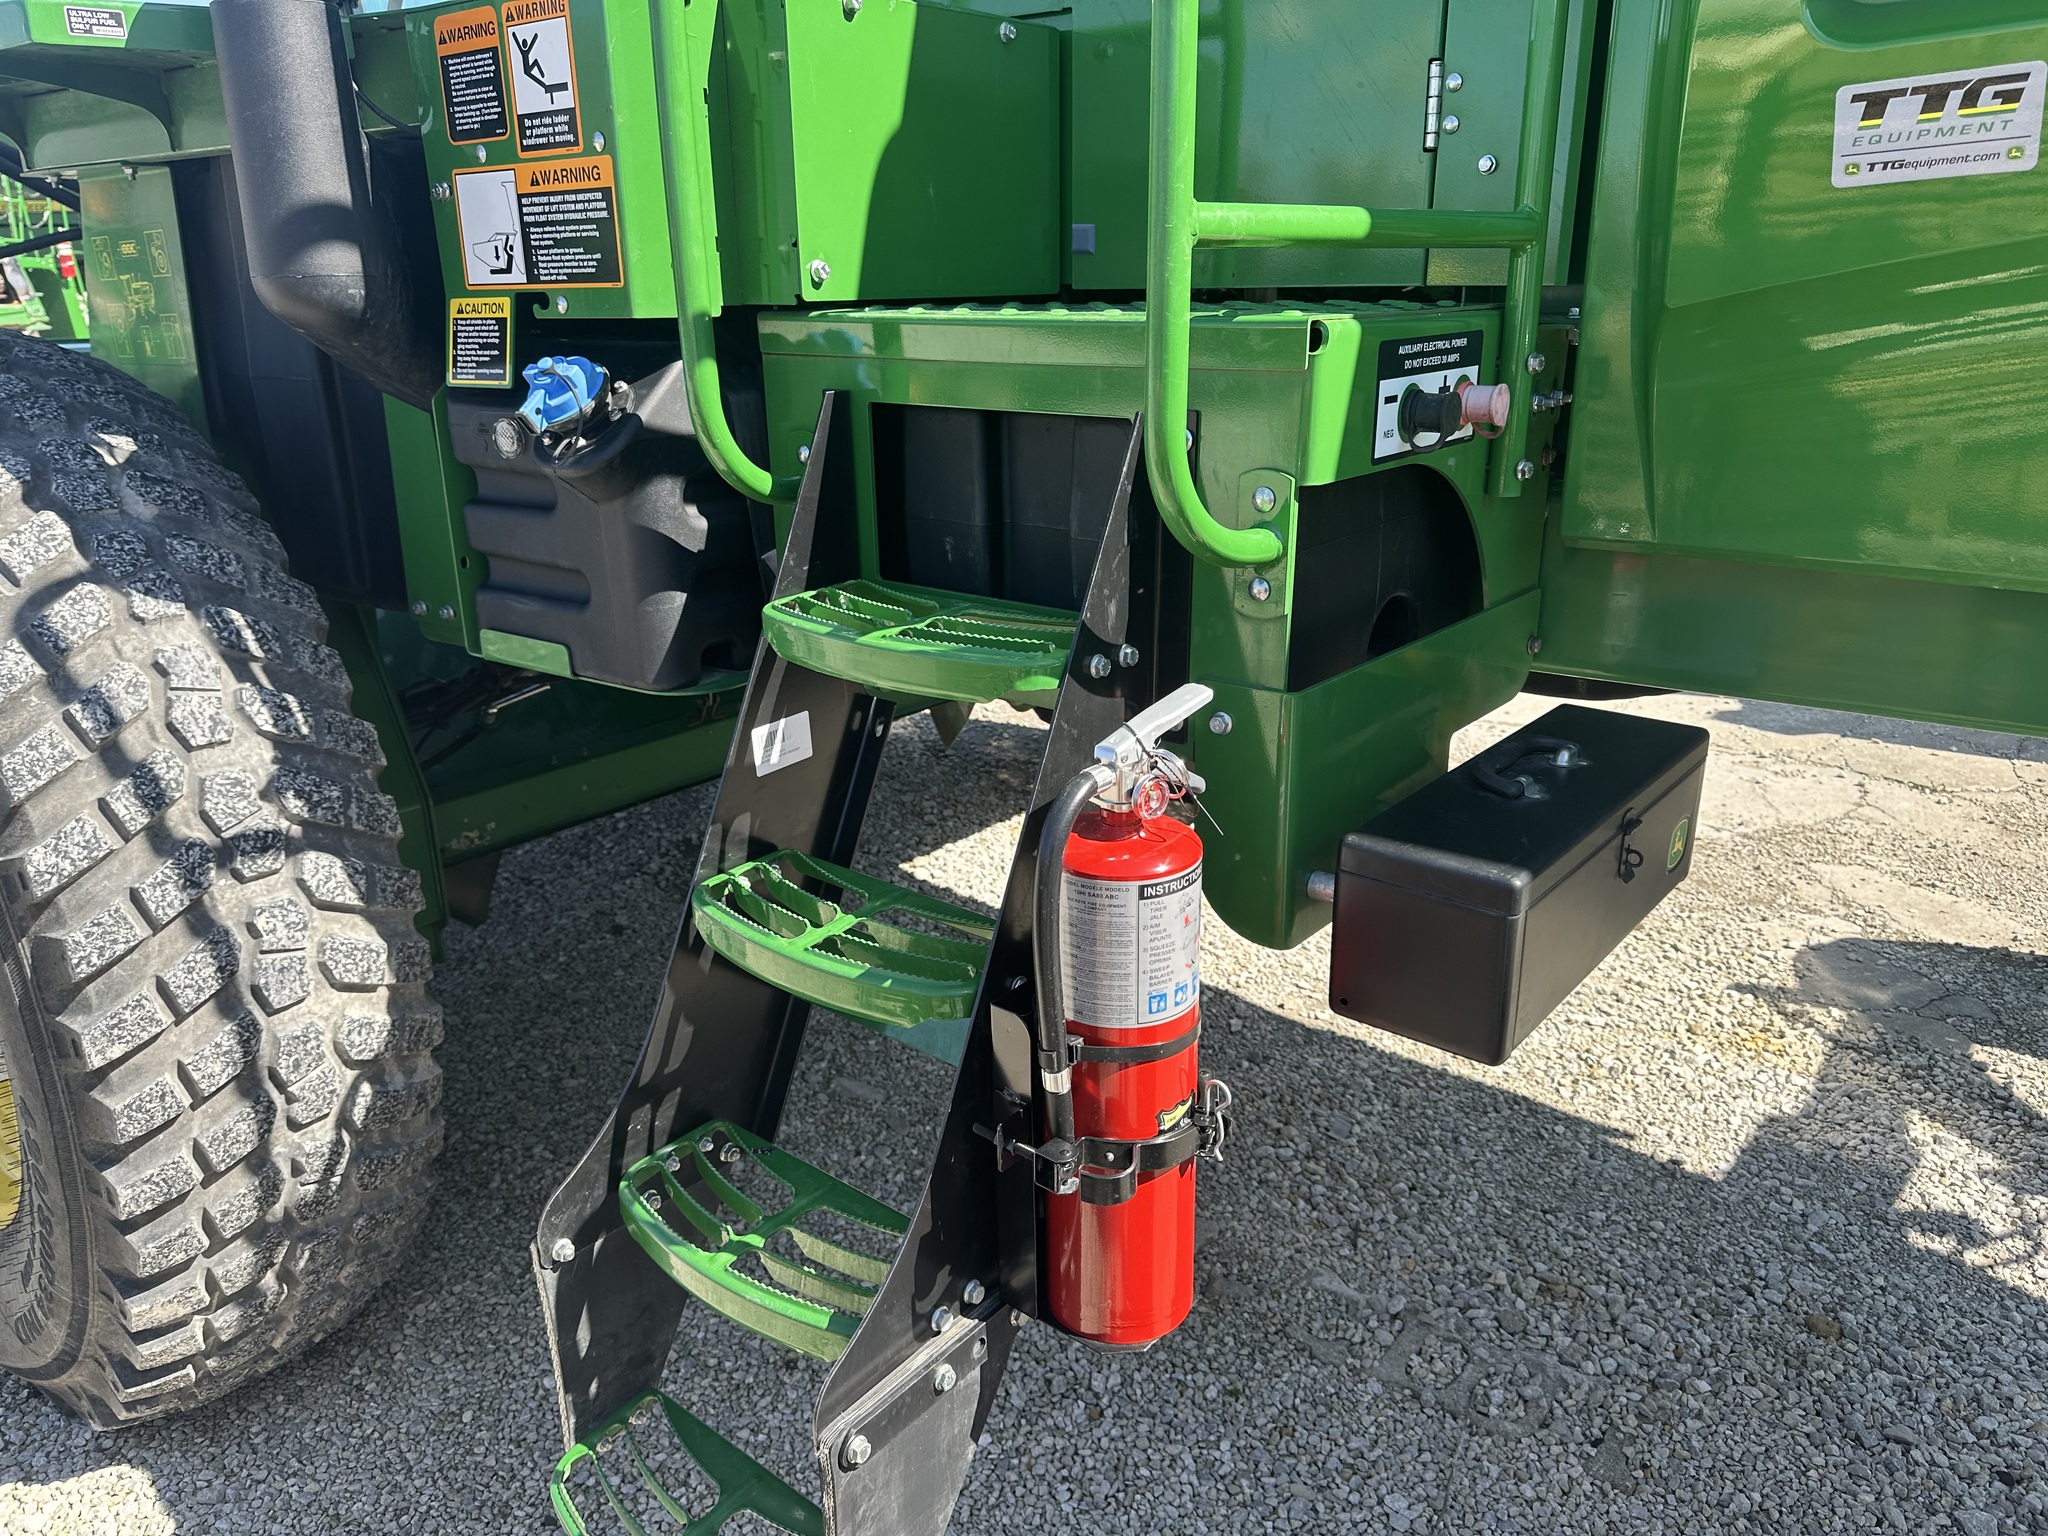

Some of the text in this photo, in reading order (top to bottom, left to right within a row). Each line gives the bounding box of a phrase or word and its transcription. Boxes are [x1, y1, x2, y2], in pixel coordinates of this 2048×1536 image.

[69, 10, 93, 18] ULTRA
[515, 0, 565, 20] WARNING
[70, 16, 99, 25] SULFUR
[446, 21, 496, 43] WARNING
[1850, 72, 2031, 131] TTG
[524, 114, 569, 127] Do not ride ladder
[532, 126, 554, 137] platform
[554, 124, 568, 133] while
[1852, 119, 2014, 147] EQUIPMENT
[522, 133, 576, 146] windrower is moving.
[1867, 152, 2000, 172] TTGequipment.com
[540, 165, 601, 185] WARNING
[532, 196, 549, 204] PREVENT
[564, 194, 576, 202] FROM
[577, 192, 602, 201] UNEXPECTED
[584, 202, 606, 210] PLATFORM
[535, 214, 547, 222] FLOAT
[564, 212, 586, 220] HYDRAULIC
[465, 303, 504, 314] CAUTION
[1398, 338, 1467, 355] AUXILIARY ELECTRICAL POWER
[1405, 353, 1460, 369] DO NOT EXCEED 30 AMPS
[1383, 429, 1394, 439] NEG
[1150, 913, 1164, 921] JALE
[1149, 928, 1167, 936] VISER
[1149, 933, 1172, 943] APUNTE
[1150, 941, 1176, 952] SQUEEZE
[1149, 947, 1176, 958] PRESSER
[1149, 957, 1171, 965] OPRIMA
[1149, 965, 1170, 974] SWEEP
[1149, 970, 1174, 981] BALAYER
[1149, 978, 1172, 987] BARRER
